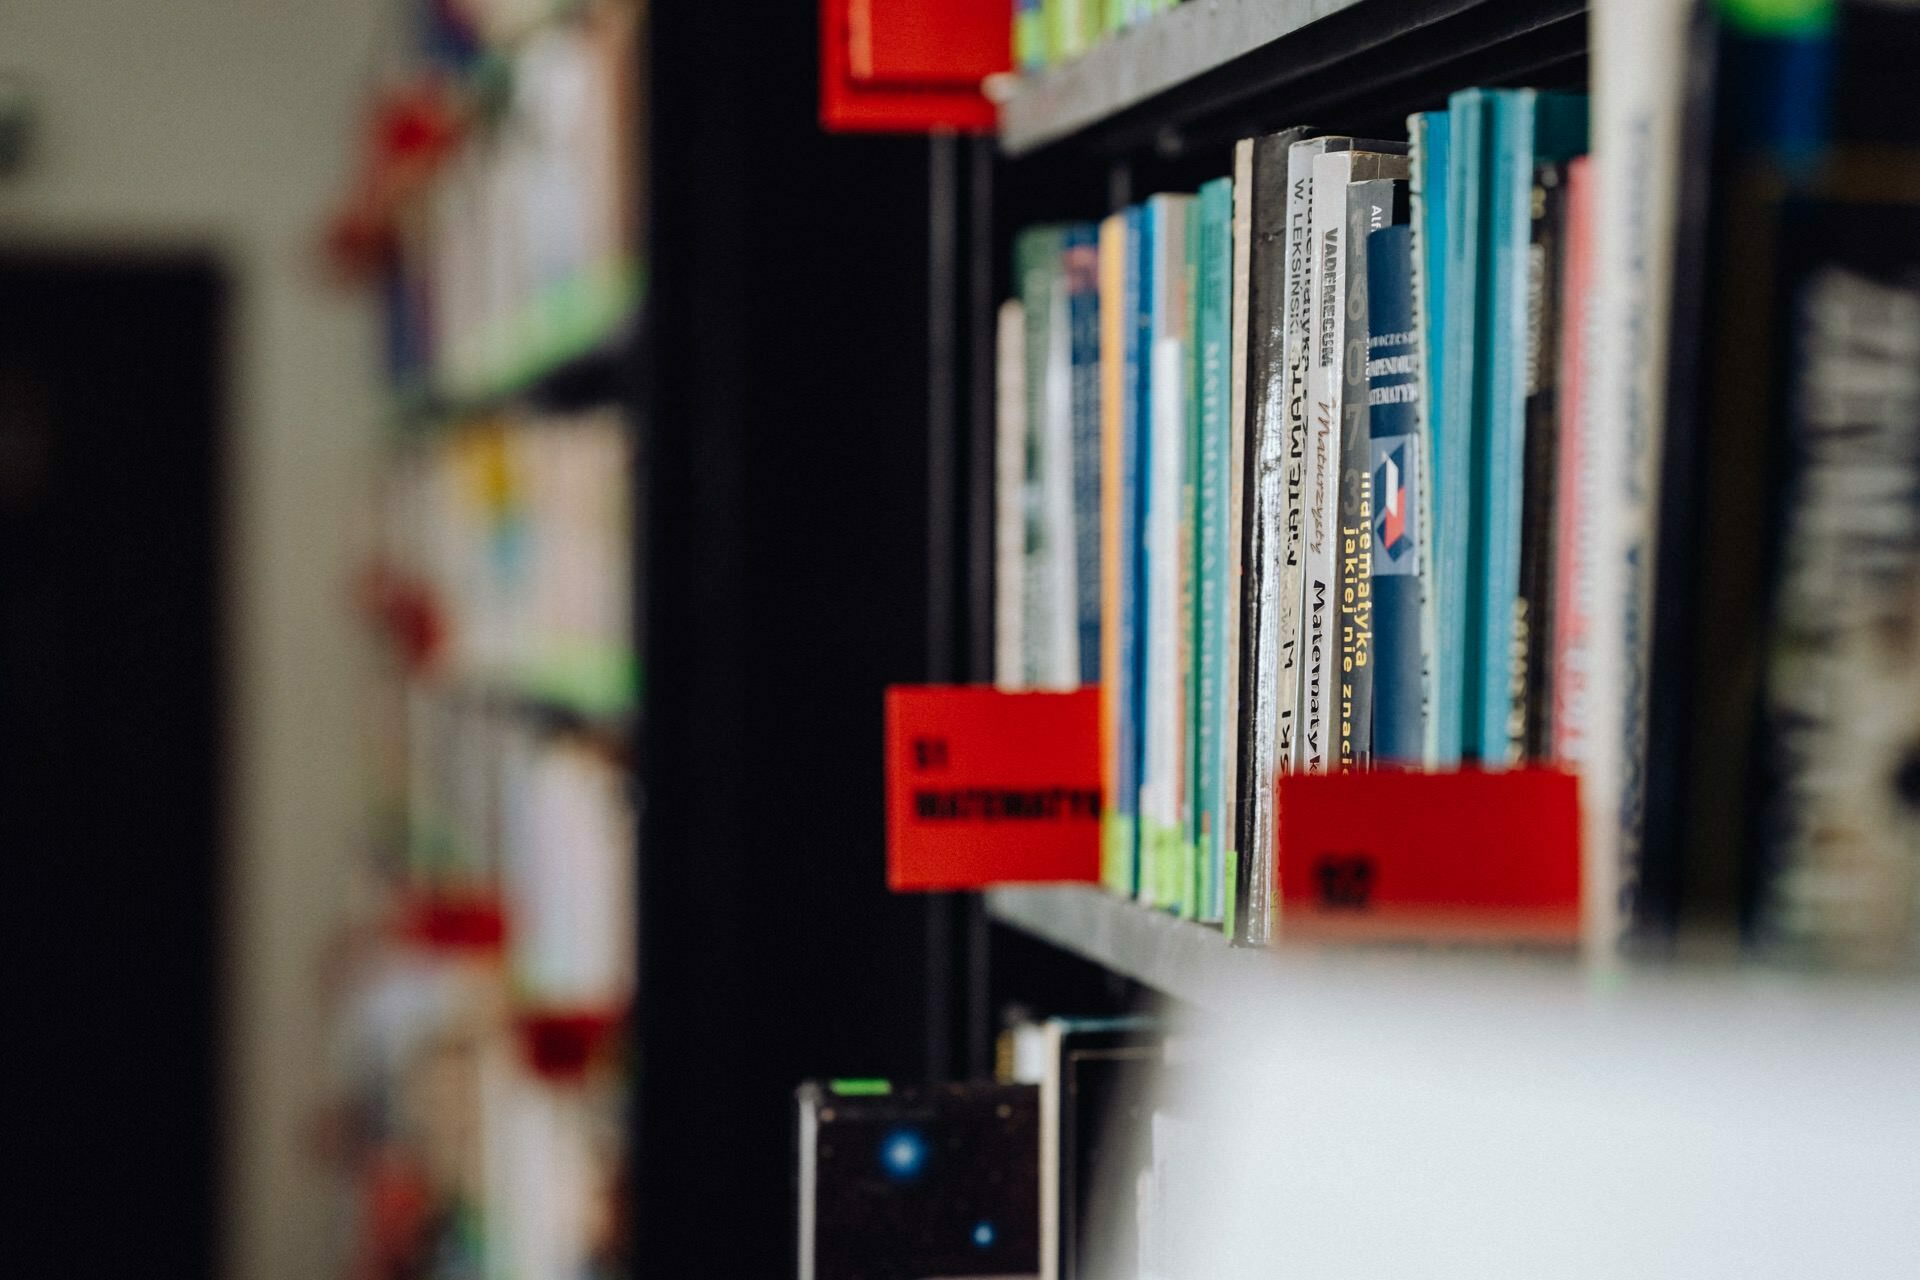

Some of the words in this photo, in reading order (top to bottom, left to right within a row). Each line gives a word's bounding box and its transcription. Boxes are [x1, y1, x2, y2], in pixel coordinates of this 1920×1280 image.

[1370, 205, 1383, 233] Alf
[1322, 228, 1339, 367] VADEMECUM
[1342, 526, 1359, 613] jakiej
[1308, 579, 1326, 774] Matematyk
[1343, 626, 1356, 673] nie
